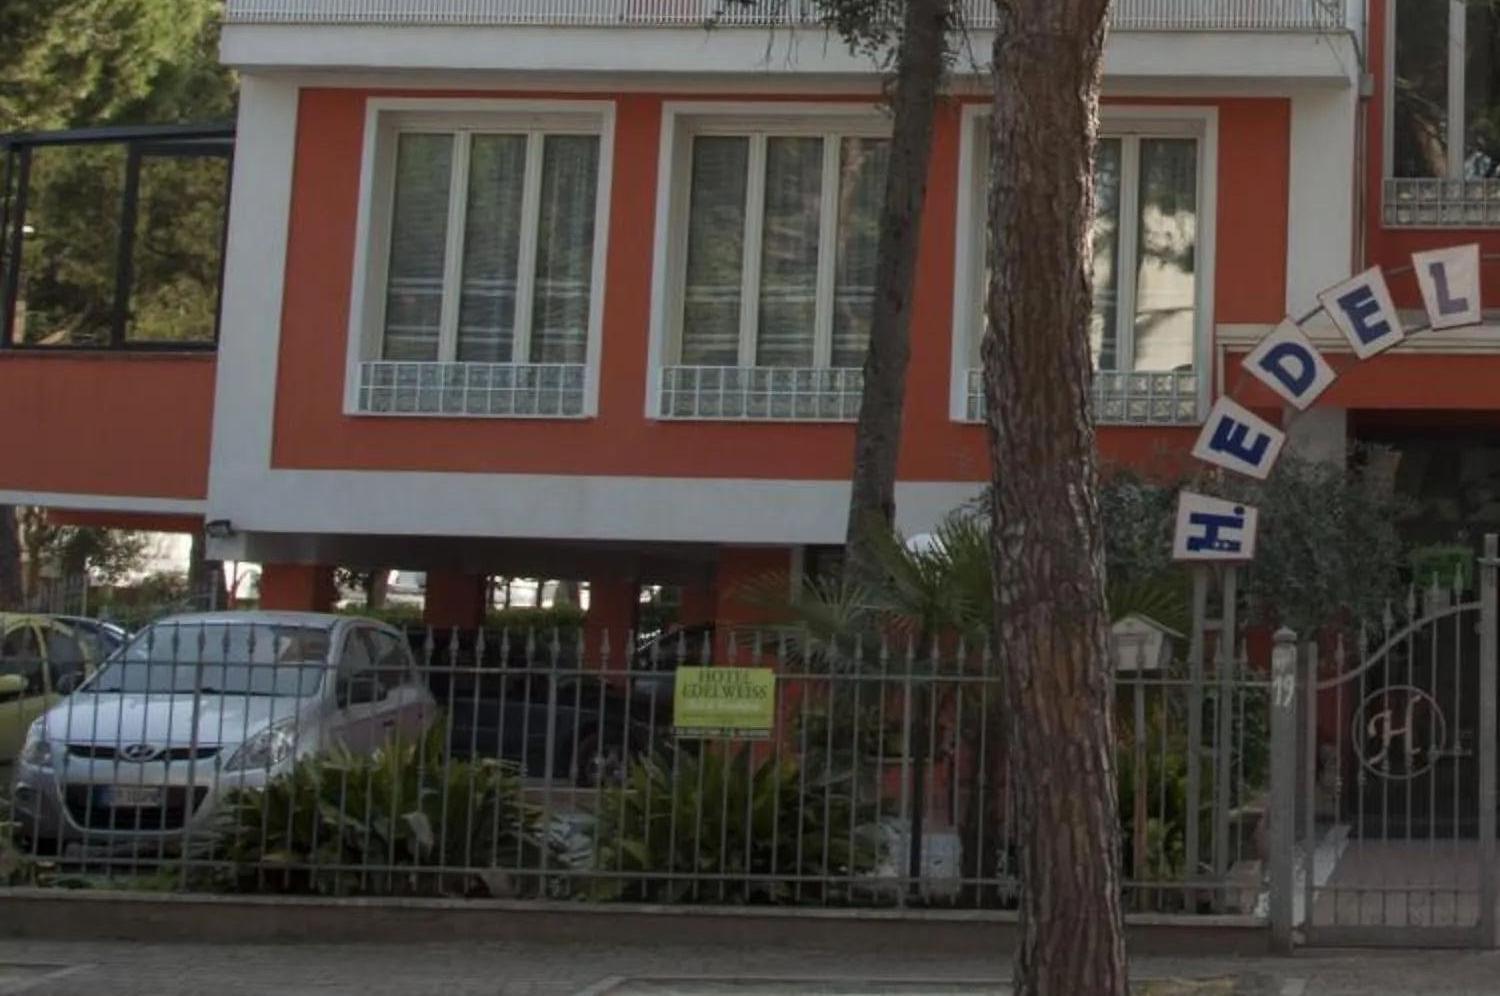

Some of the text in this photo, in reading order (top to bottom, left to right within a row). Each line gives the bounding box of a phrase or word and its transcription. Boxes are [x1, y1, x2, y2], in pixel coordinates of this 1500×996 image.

[699, 669, 752, 684] HOTEL
[682, 682, 769, 700] EDELWEISS
[1271, 674, 1295, 707] 19
[1367, 694, 1423, 765] H
